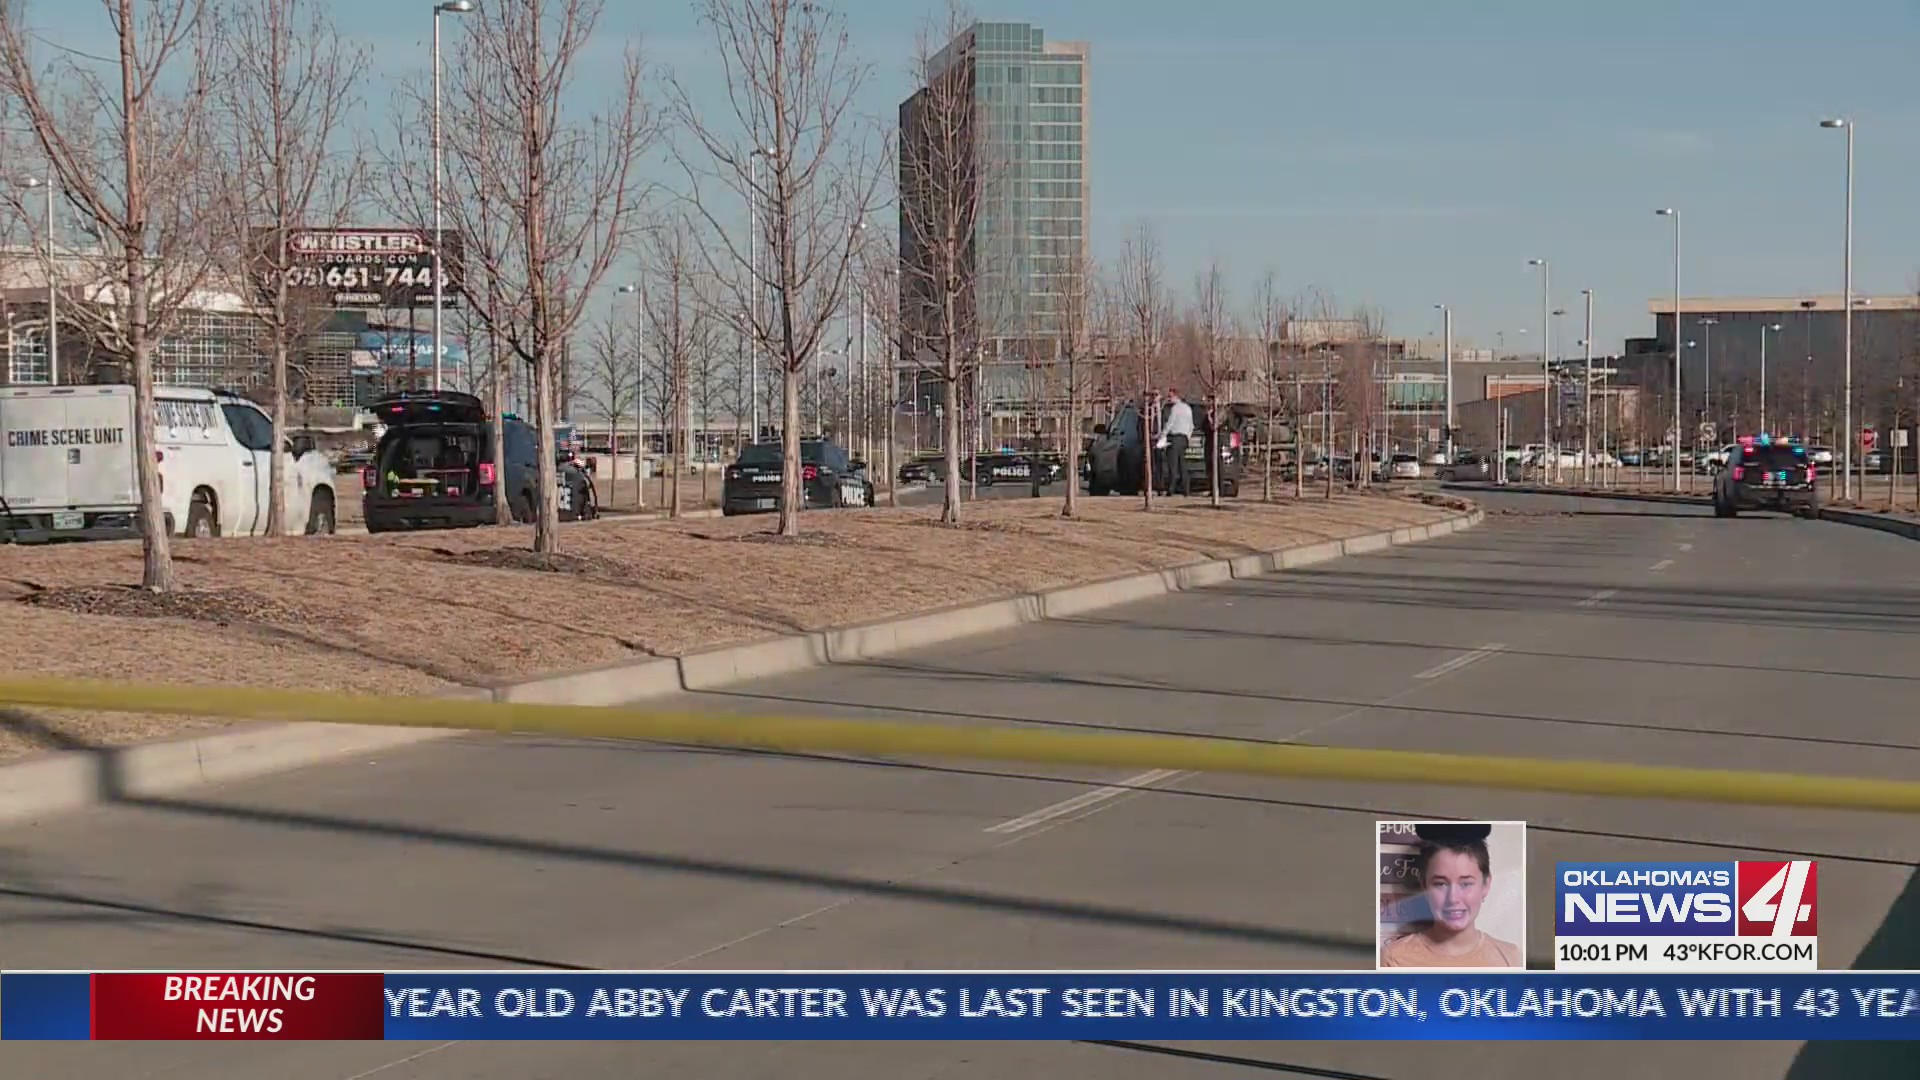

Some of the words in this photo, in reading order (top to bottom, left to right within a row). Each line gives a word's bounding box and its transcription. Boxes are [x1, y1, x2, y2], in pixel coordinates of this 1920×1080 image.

[8, 430, 48, 447] CRIME
[51, 428, 92, 446] SCENE
[94, 427, 123, 444] UNIT
[993, 464, 1031, 477] POLICE
